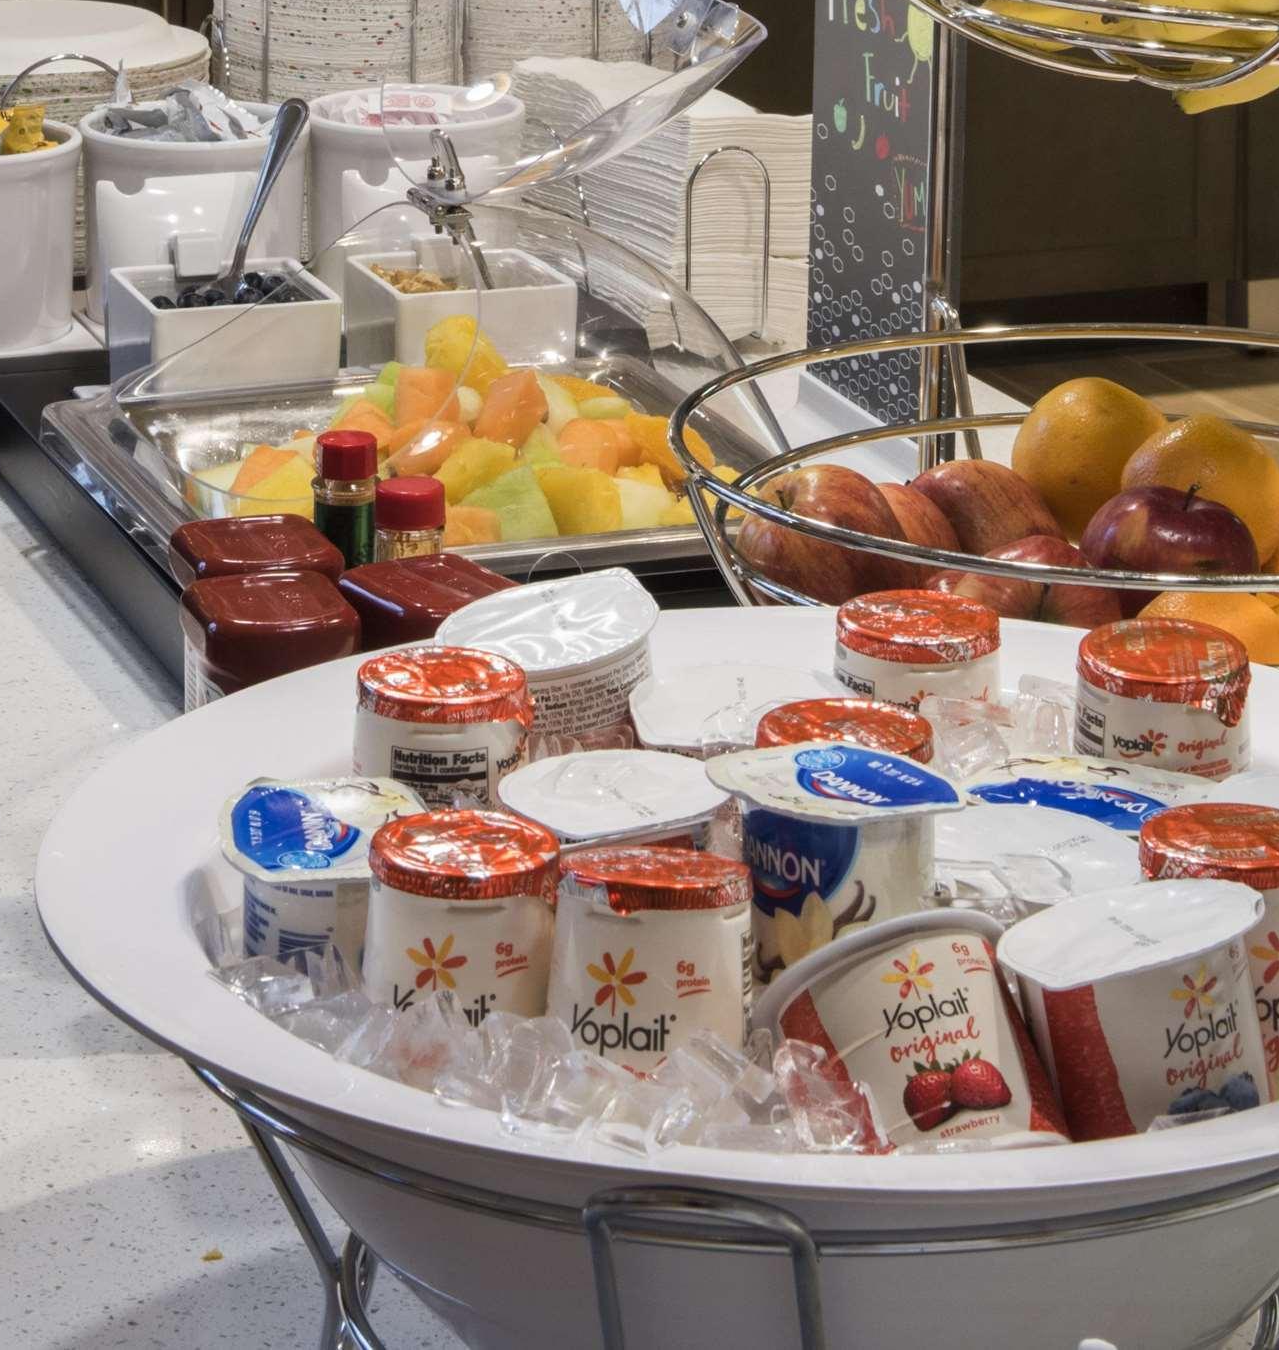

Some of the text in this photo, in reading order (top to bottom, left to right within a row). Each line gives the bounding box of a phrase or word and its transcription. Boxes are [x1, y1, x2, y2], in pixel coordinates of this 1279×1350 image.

[862, 52, 910, 122] Fruit
[894, 166, 926, 223] YUM
[393, 749, 487, 766] Nutrition Facts
[1112, 733, 1155, 753] Yoplait
[1177, 729, 1227, 759] original
[811, 769, 892, 804] DANNON
[746, 834, 820, 888] ANNON
[495, 942, 514, 957] 6g
[495, 953, 528, 969] protein
[951, 941, 969, 956] 6g
[956, 956, 988, 969] protein
[676, 959, 695, 976] 6g
[676, 975, 711, 990] protein
[883, 988, 969, 1038] Yoplait
[571, 1003, 672, 1056] Yoplait
[890, 1016, 981, 1063] original
[1164, 1002, 1238, 1059] Yoplait
[1166, 1032, 1244, 1090] original
[940, 1113, 1001, 1139] strawberry
